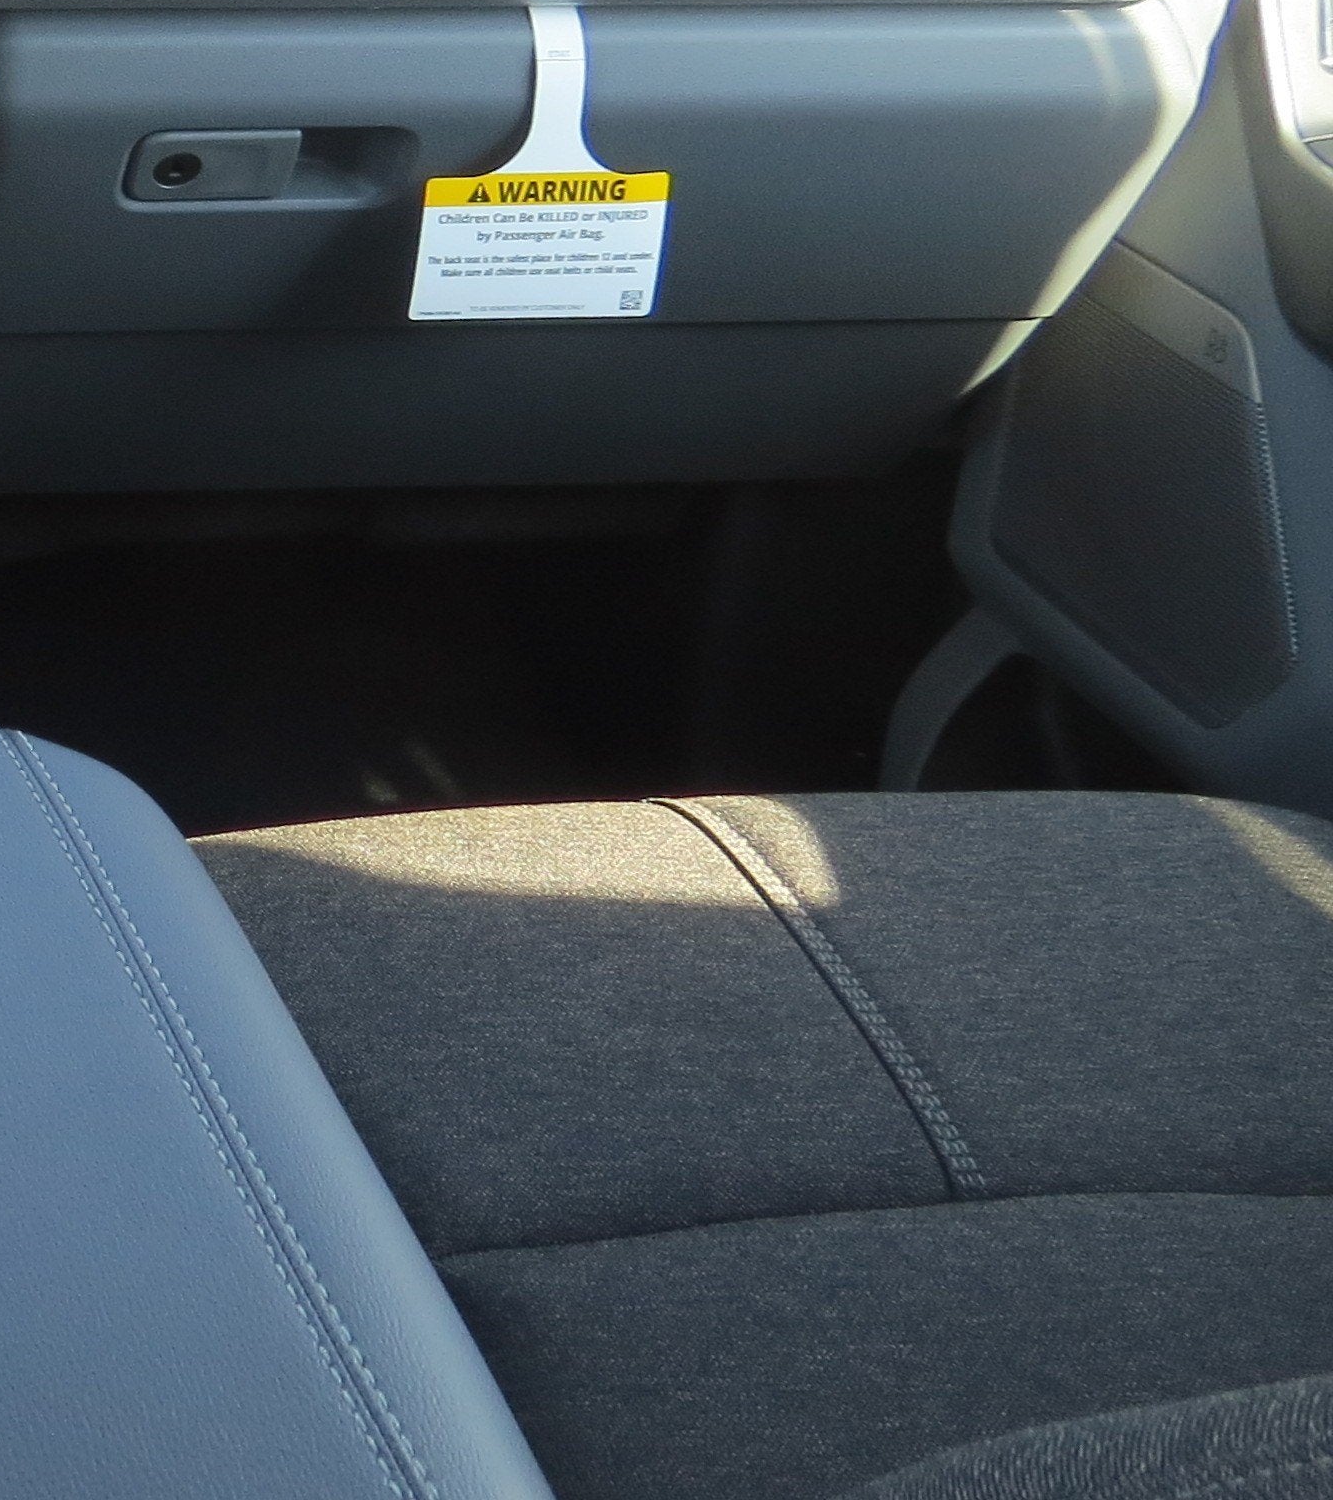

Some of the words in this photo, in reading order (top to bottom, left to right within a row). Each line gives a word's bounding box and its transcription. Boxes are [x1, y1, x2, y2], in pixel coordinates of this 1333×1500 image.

[498, 180, 626, 203] WARNING
[438, 213, 490, 224] Children
[493, 212, 515, 223] Can
[519, 212, 534, 222] Be
[537, 212, 579, 222] KILLED
[597, 210, 648, 221] INJURED
[477, 231, 492, 243] by
[494, 229, 556, 243] Passenger
[558, 229, 577, 239] Air
[579, 228, 605, 241] Bag.
